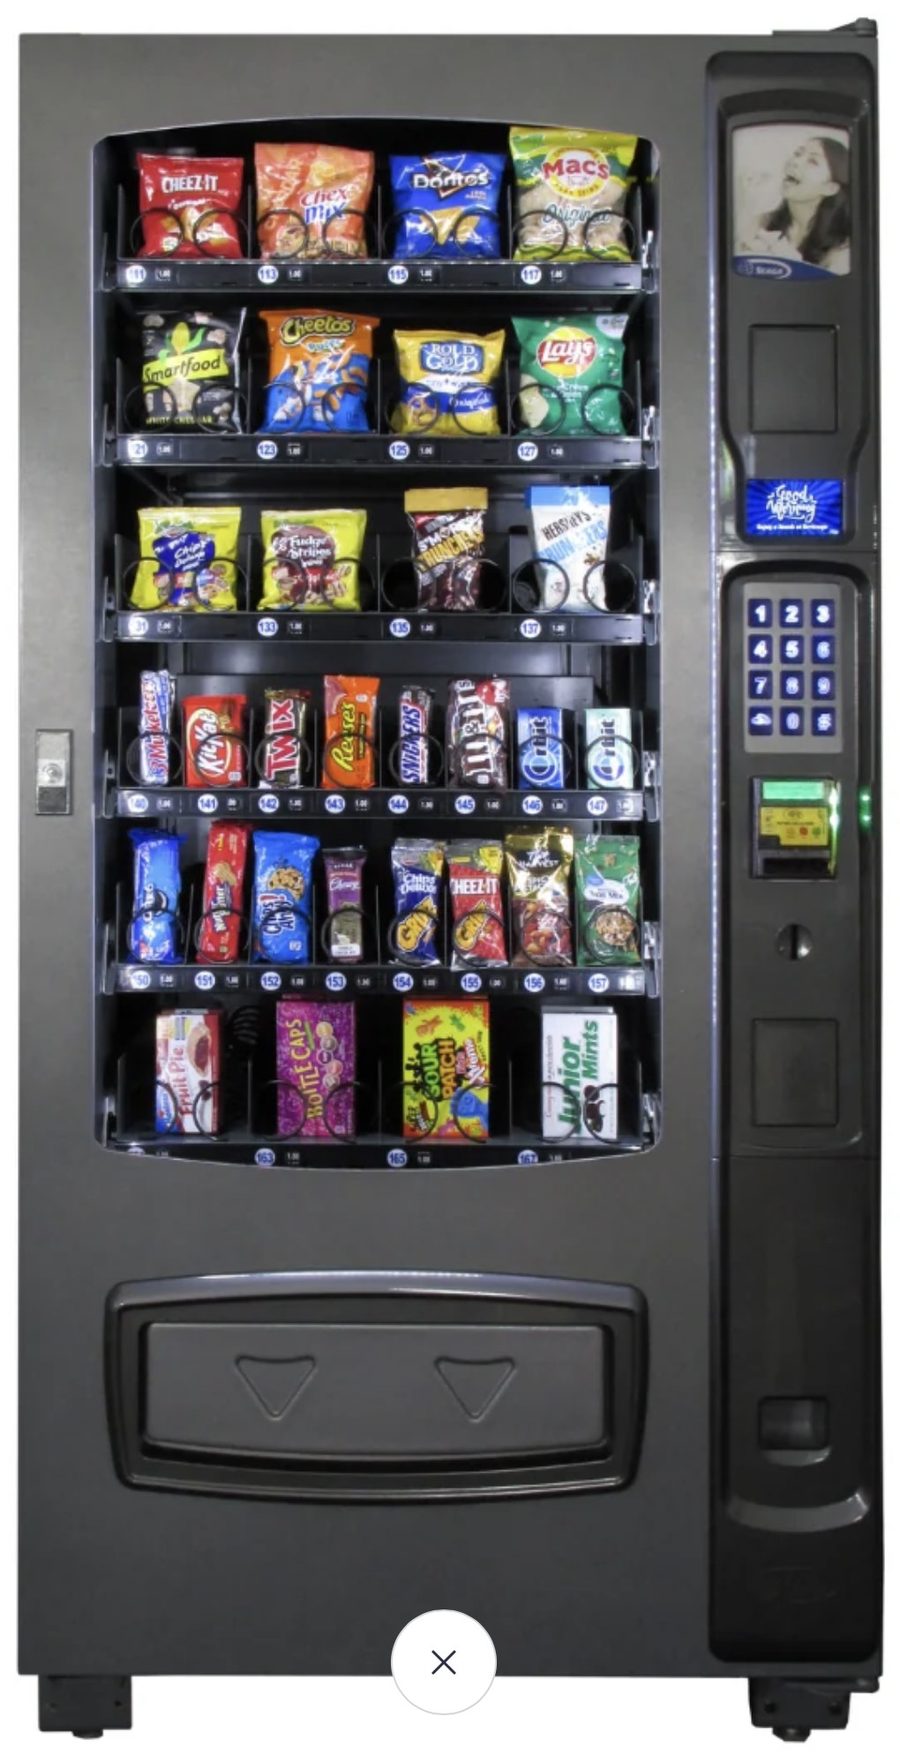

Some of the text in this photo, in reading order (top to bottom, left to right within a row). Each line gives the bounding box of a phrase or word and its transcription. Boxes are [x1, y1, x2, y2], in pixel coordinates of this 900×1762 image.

[542, 157, 609, 180] Mac's
[161, 174, 219, 193] CHEEZ-IT
[412, 172, 489, 189] Doritos
[281, 316, 353, 345] Cheetos
[144, 354, 221, 383] Smartfood
[425, 353, 478, 372] GOLD
[755, 604, 766, 623] 1
[785, 604, 799, 623] 2
[816, 604, 830, 623] 3
[753, 640, 768, 658] 4
[785, 640, 799, 658] 5
[816, 641, 830, 659] 6
[754, 676, 768, 695] 7
[785, 676, 799, 695] 8
[817, 676, 830, 695] 9
[786, 711, 800, 730] 0
[264, 698, 298, 780] TWIX
[286, 1019, 311, 1060] CAPS
[582, 1020, 599, 1080] Mints
[168, 1047, 185, 1073] Pie
[440, 1039, 457, 1099] PATCH
[421, 1044, 440, 1097] SOUR
[172, 1074, 193, 1116] Fruit
